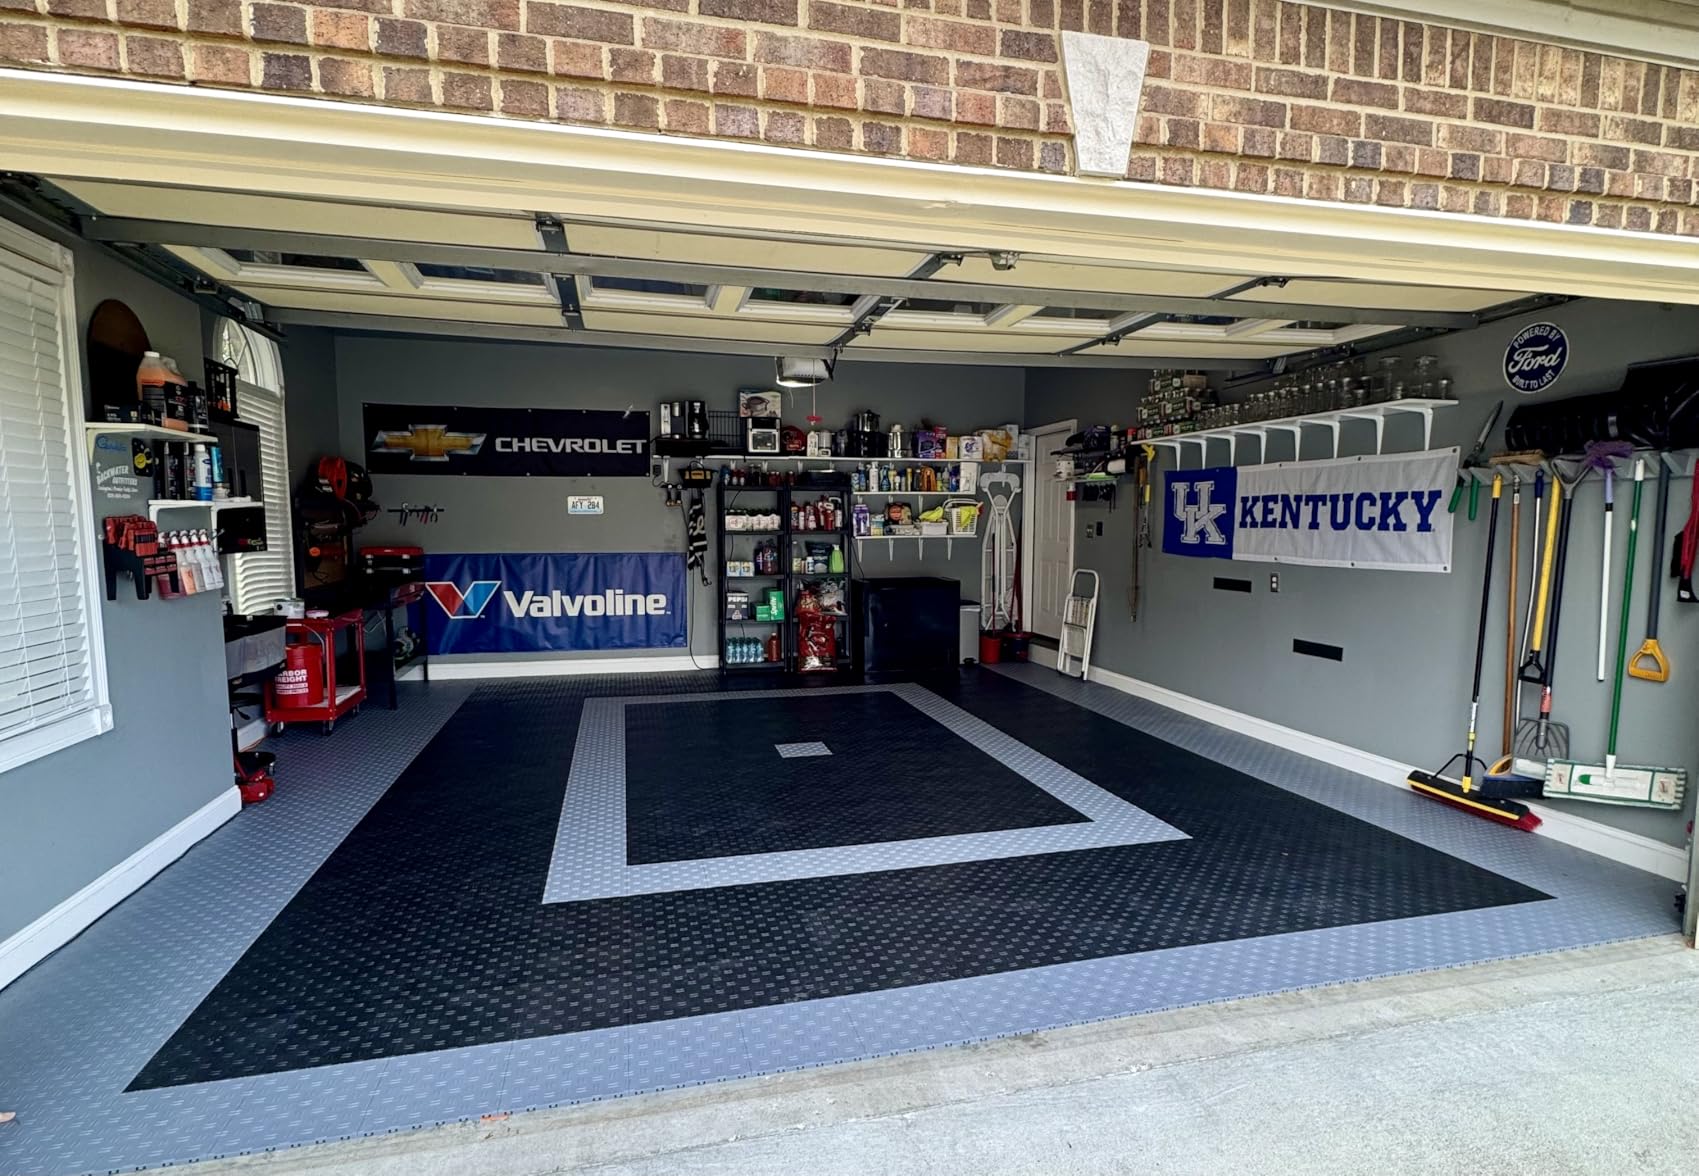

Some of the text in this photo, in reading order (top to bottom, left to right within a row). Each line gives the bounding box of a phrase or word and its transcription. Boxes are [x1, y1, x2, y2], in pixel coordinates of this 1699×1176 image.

[1513, 326, 1561, 349] POWERED BY
[1508, 344, 1563, 373] Ford
[1512, 369, 1555, 389] BUILT TO LAST
[495, 437, 647, 454] CHEVROLET
[1171, 481, 1227, 544] UK
[1239, 490, 1442, 532] KENTUCKY
[504, 589, 667, 618] Valvoline
[277, 669, 307, 677] ARBOR
